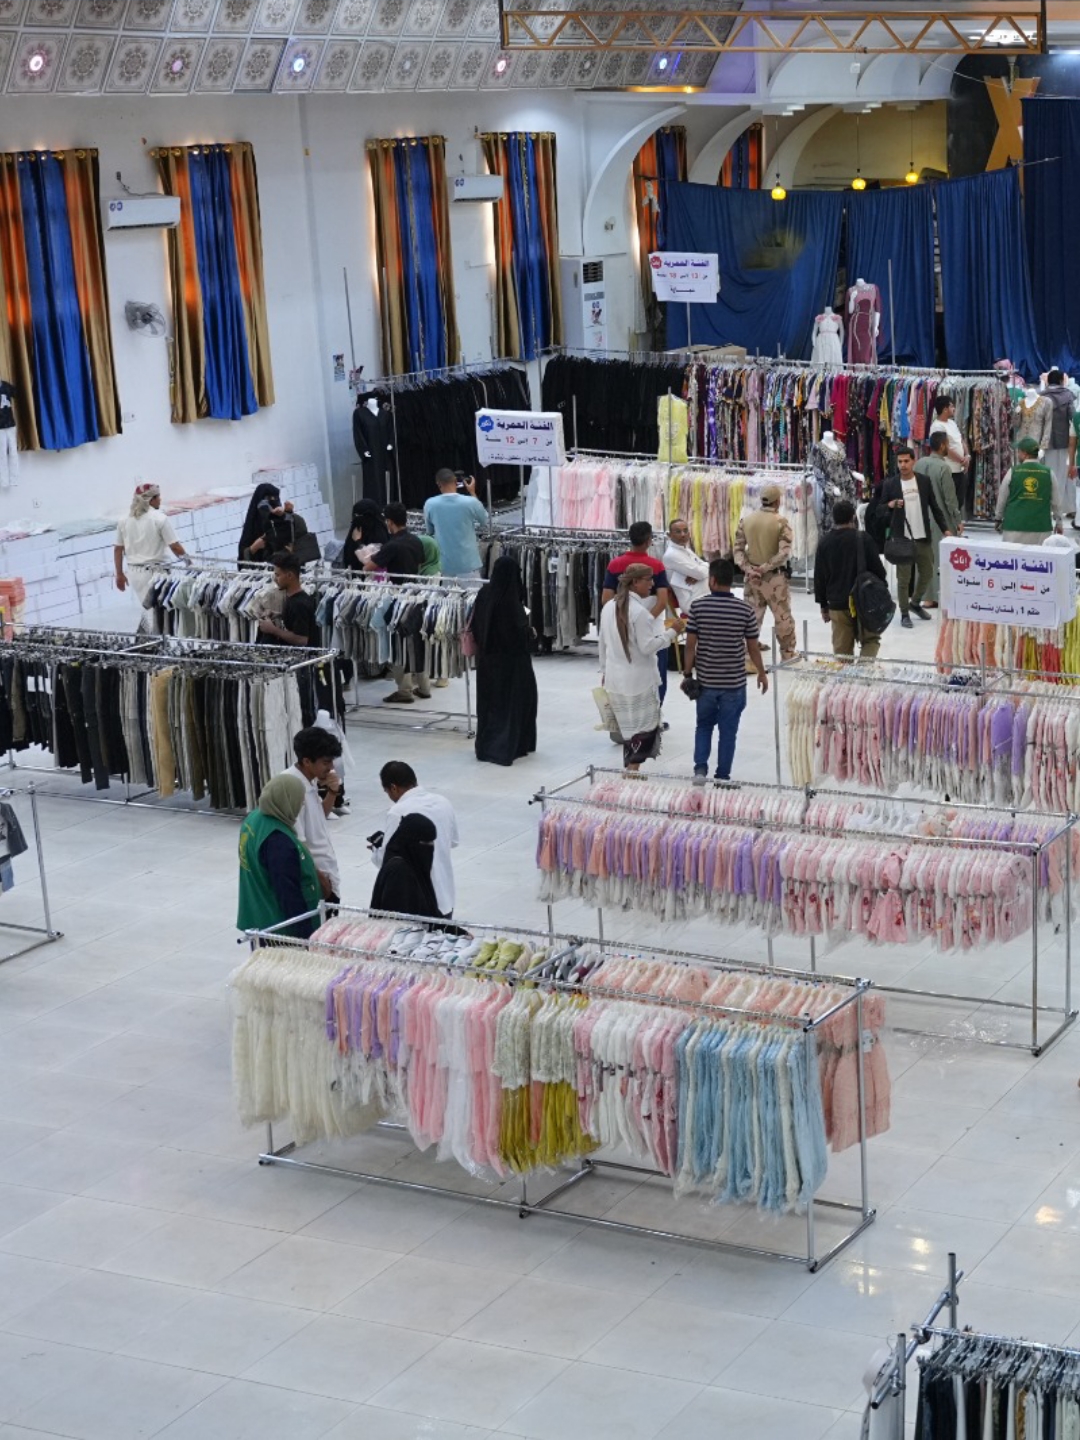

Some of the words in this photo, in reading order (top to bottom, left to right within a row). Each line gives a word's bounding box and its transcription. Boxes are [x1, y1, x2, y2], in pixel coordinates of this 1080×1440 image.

[505, 436, 515, 444] 12
[533, 437, 538, 445] 7
[974, 553, 1019, 571] العمرية
[1021, 558, 1053, 574] الفئة
[957, 575, 981, 587] سنوات
[987, 578, 995, 589] 6
[1001, 581, 1016, 592] إلى
[1040, 584, 1050, 595] من
